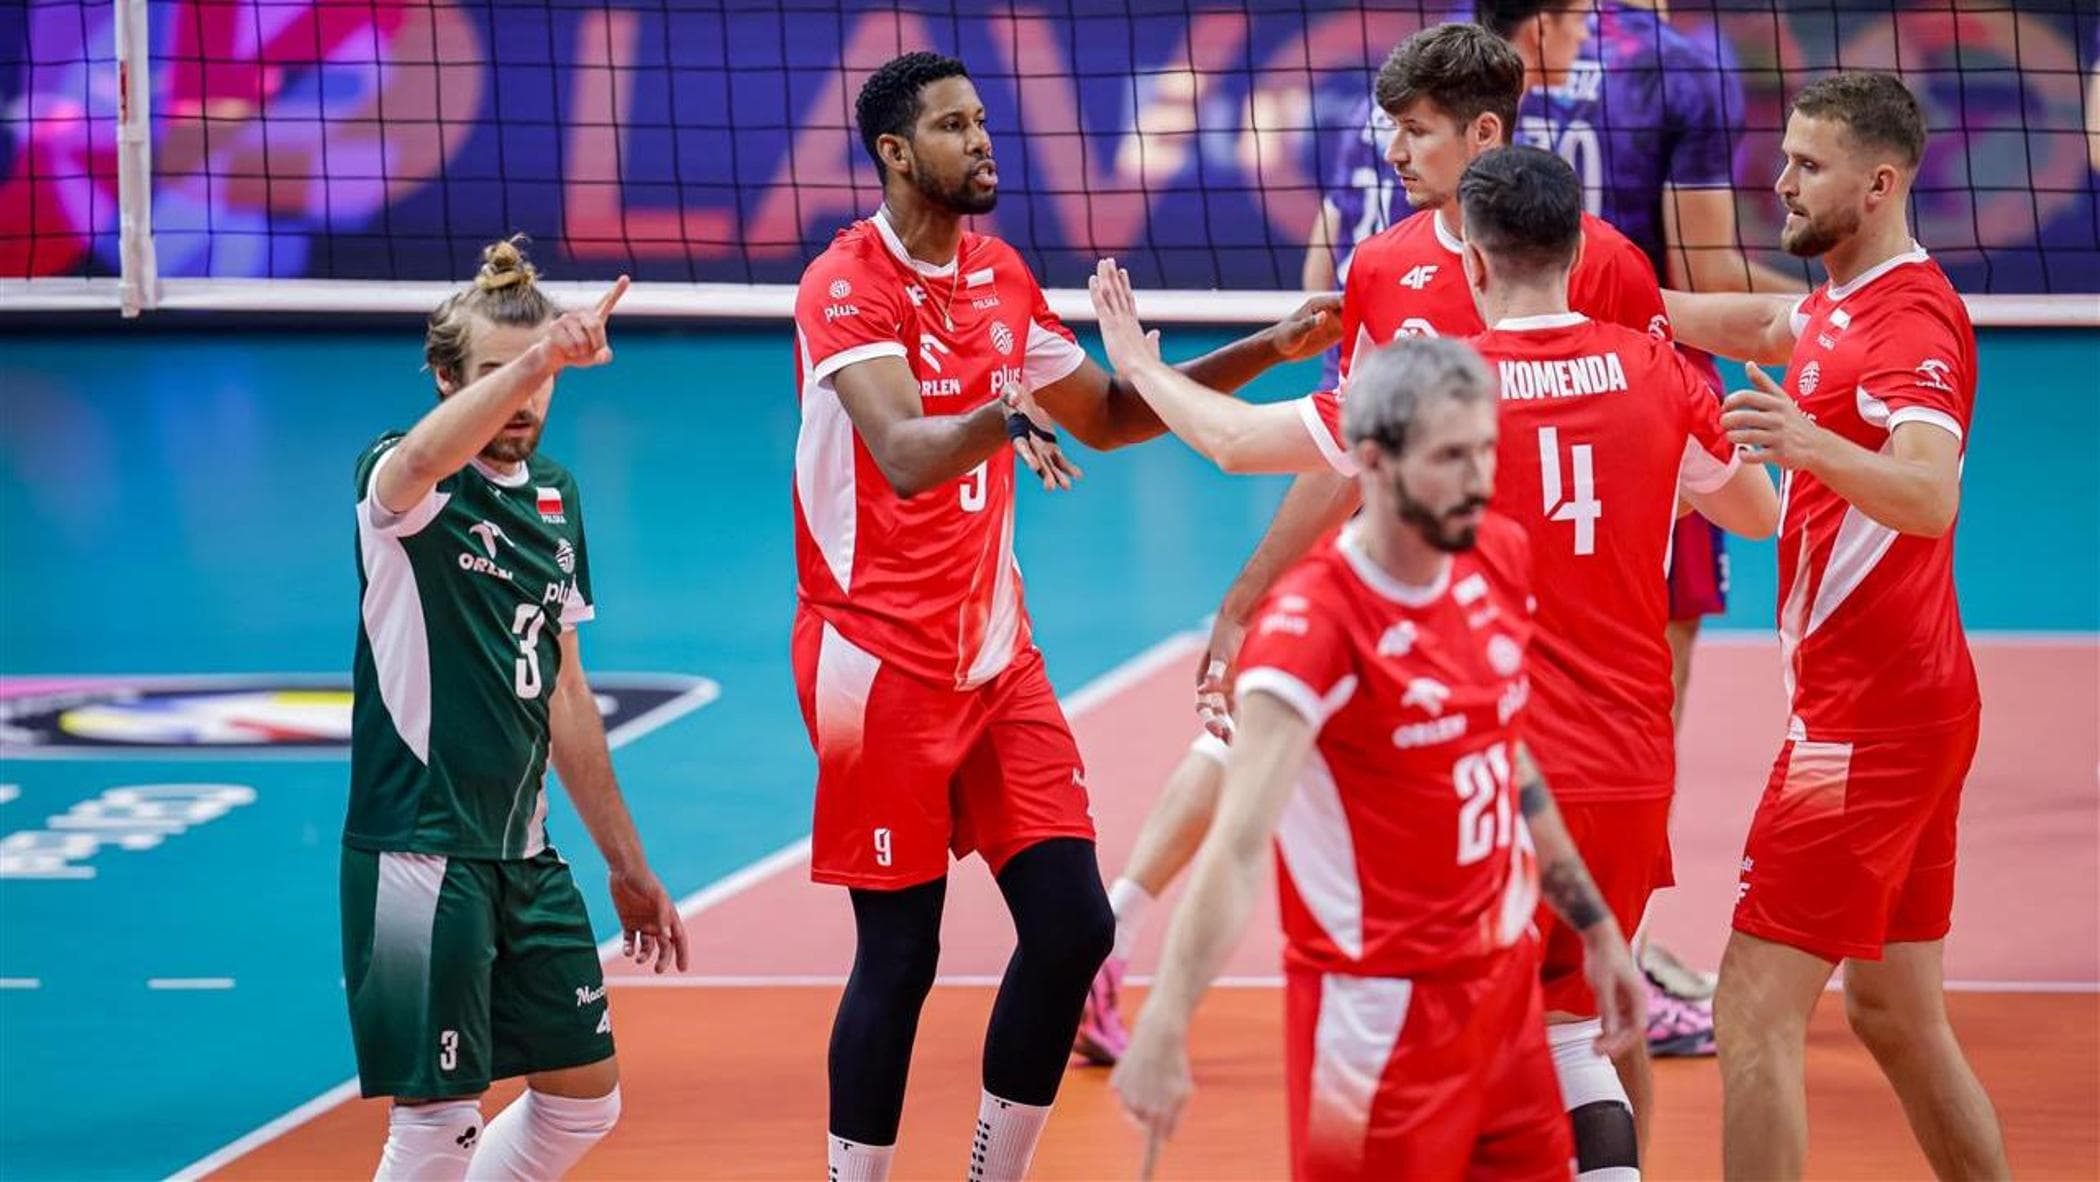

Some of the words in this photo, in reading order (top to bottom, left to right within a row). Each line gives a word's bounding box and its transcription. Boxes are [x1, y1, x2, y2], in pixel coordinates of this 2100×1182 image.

[1399, 264, 1439, 290] 4F
[824, 303, 860, 322] plus
[919, 379, 961, 396] RLEN
[1498, 352, 1628, 400] KOMENDA
[1537, 426, 1602, 555] 4
[512, 603, 545, 699] 3
[1452, 741, 1511, 867] 21
[873, 827, 892, 867] 9
[440, 1030, 459, 1071] 3
